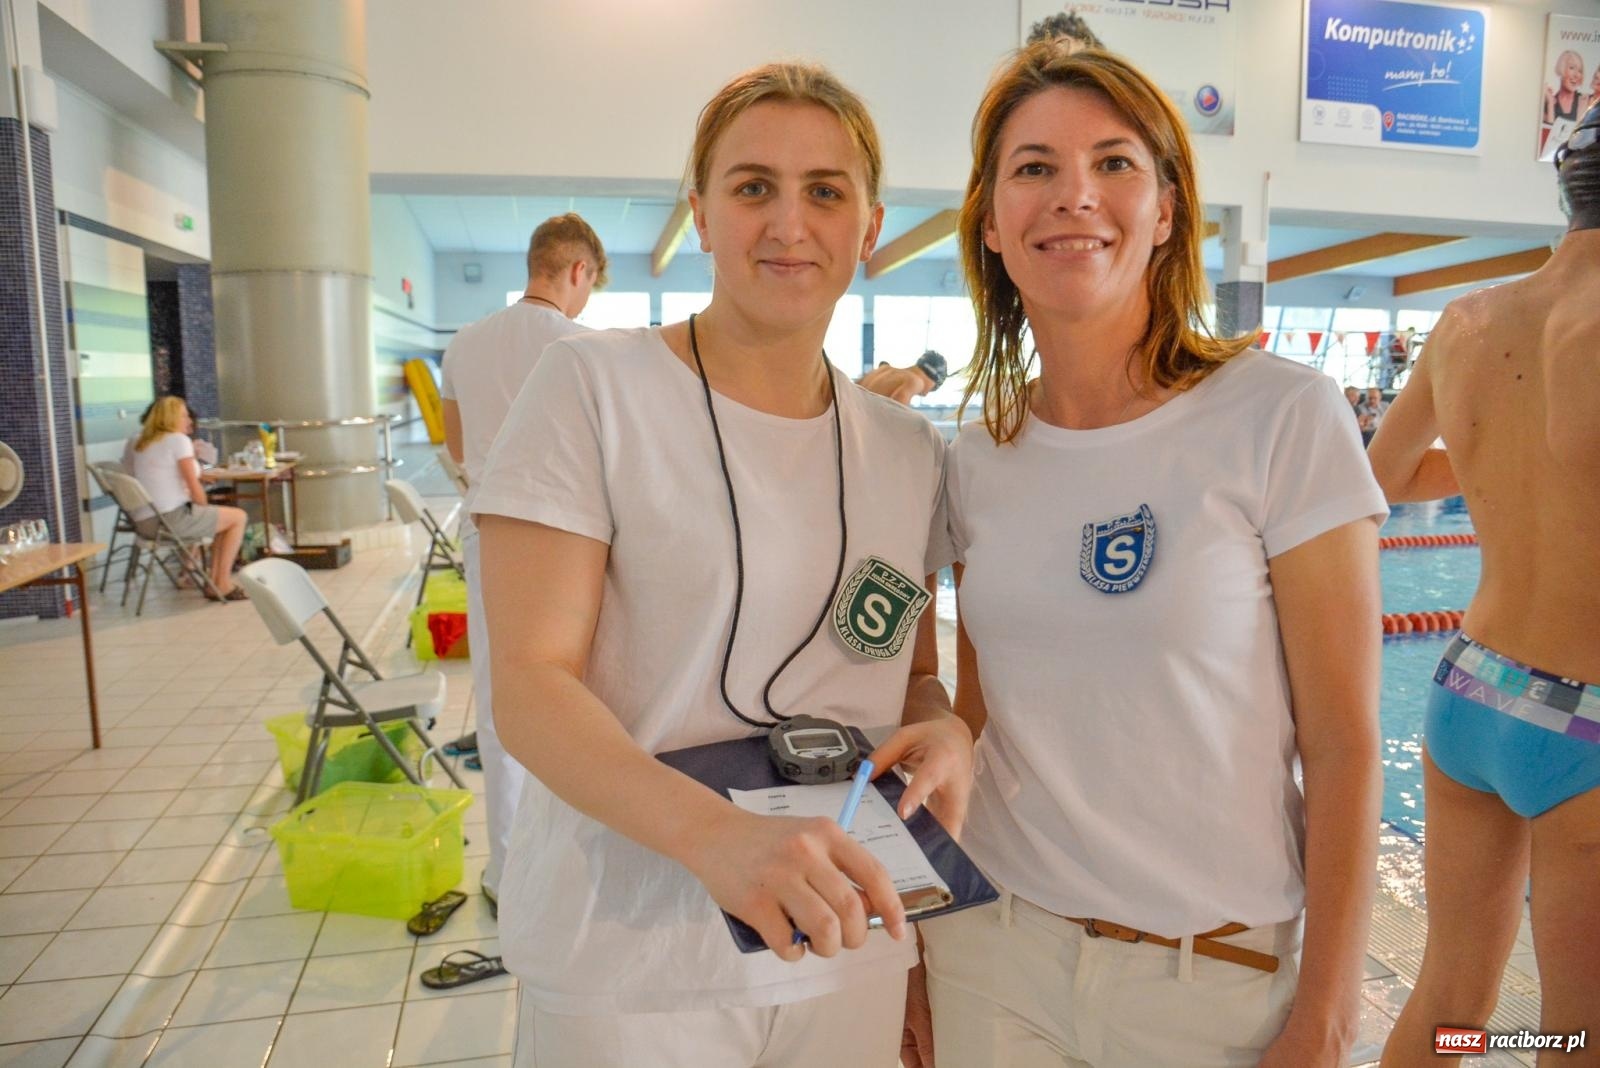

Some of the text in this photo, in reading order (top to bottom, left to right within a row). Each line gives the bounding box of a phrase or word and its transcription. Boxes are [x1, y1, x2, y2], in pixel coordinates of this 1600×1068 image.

[1325, 16, 1457, 53] Komputronik
[1560, 30, 1600, 43] www.i
[1384, 69, 1425, 87] mamy
[1103, 534, 1137, 576] S
[856, 592, 893, 638] S
[839, 625, 893, 658] KLASA DRUGA
[1449, 666, 1536, 717] WAVE
